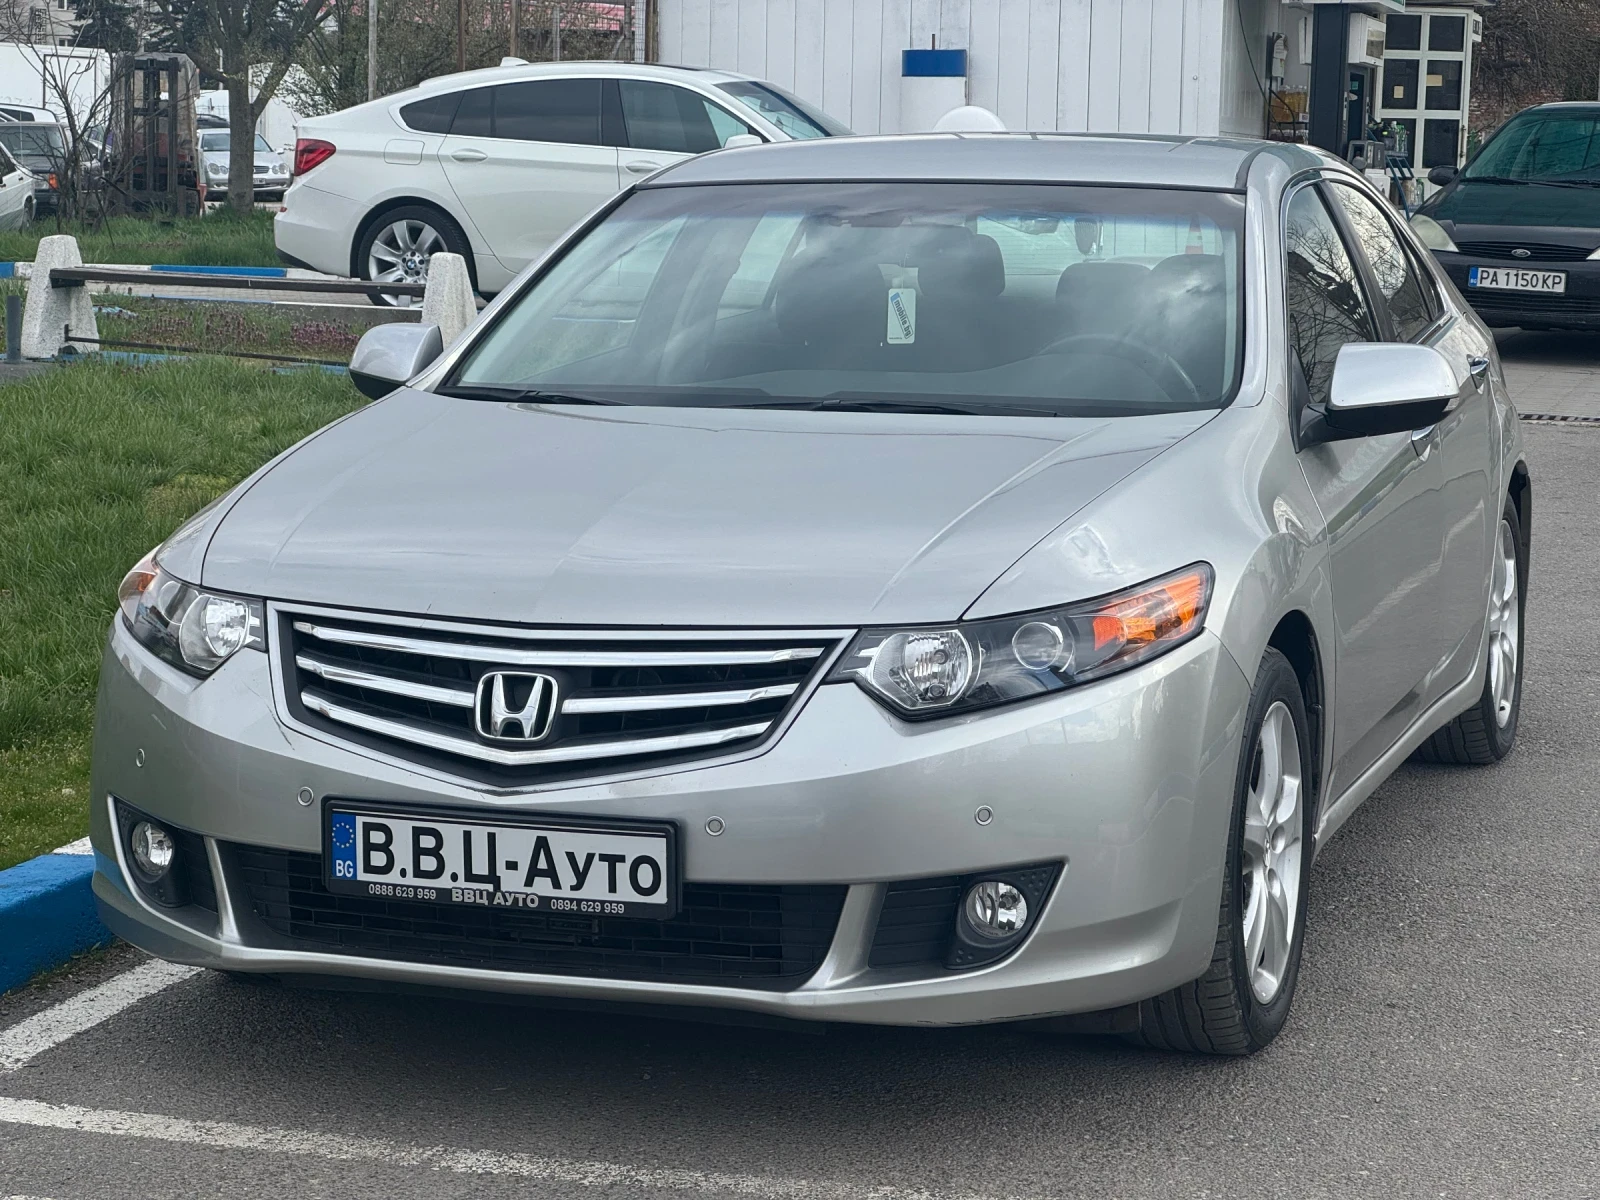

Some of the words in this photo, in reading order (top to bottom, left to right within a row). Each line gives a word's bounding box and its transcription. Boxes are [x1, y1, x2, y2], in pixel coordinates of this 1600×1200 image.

[1504, 271, 1539, 288] 1150
[894, 300, 911, 336] mobile.bg
[335, 859, 354, 878] BG
[368, 883, 394, 896] 0888
[395, 886, 414, 898] 629
[416, 888, 437, 900] 959
[451, 888, 489, 906] ВВЦ
[493, 891, 539, 908] АУТО
[550, 899, 578, 911] 0894
[580, 901, 602, 913] 629
[604, 903, 625, 914] 959
